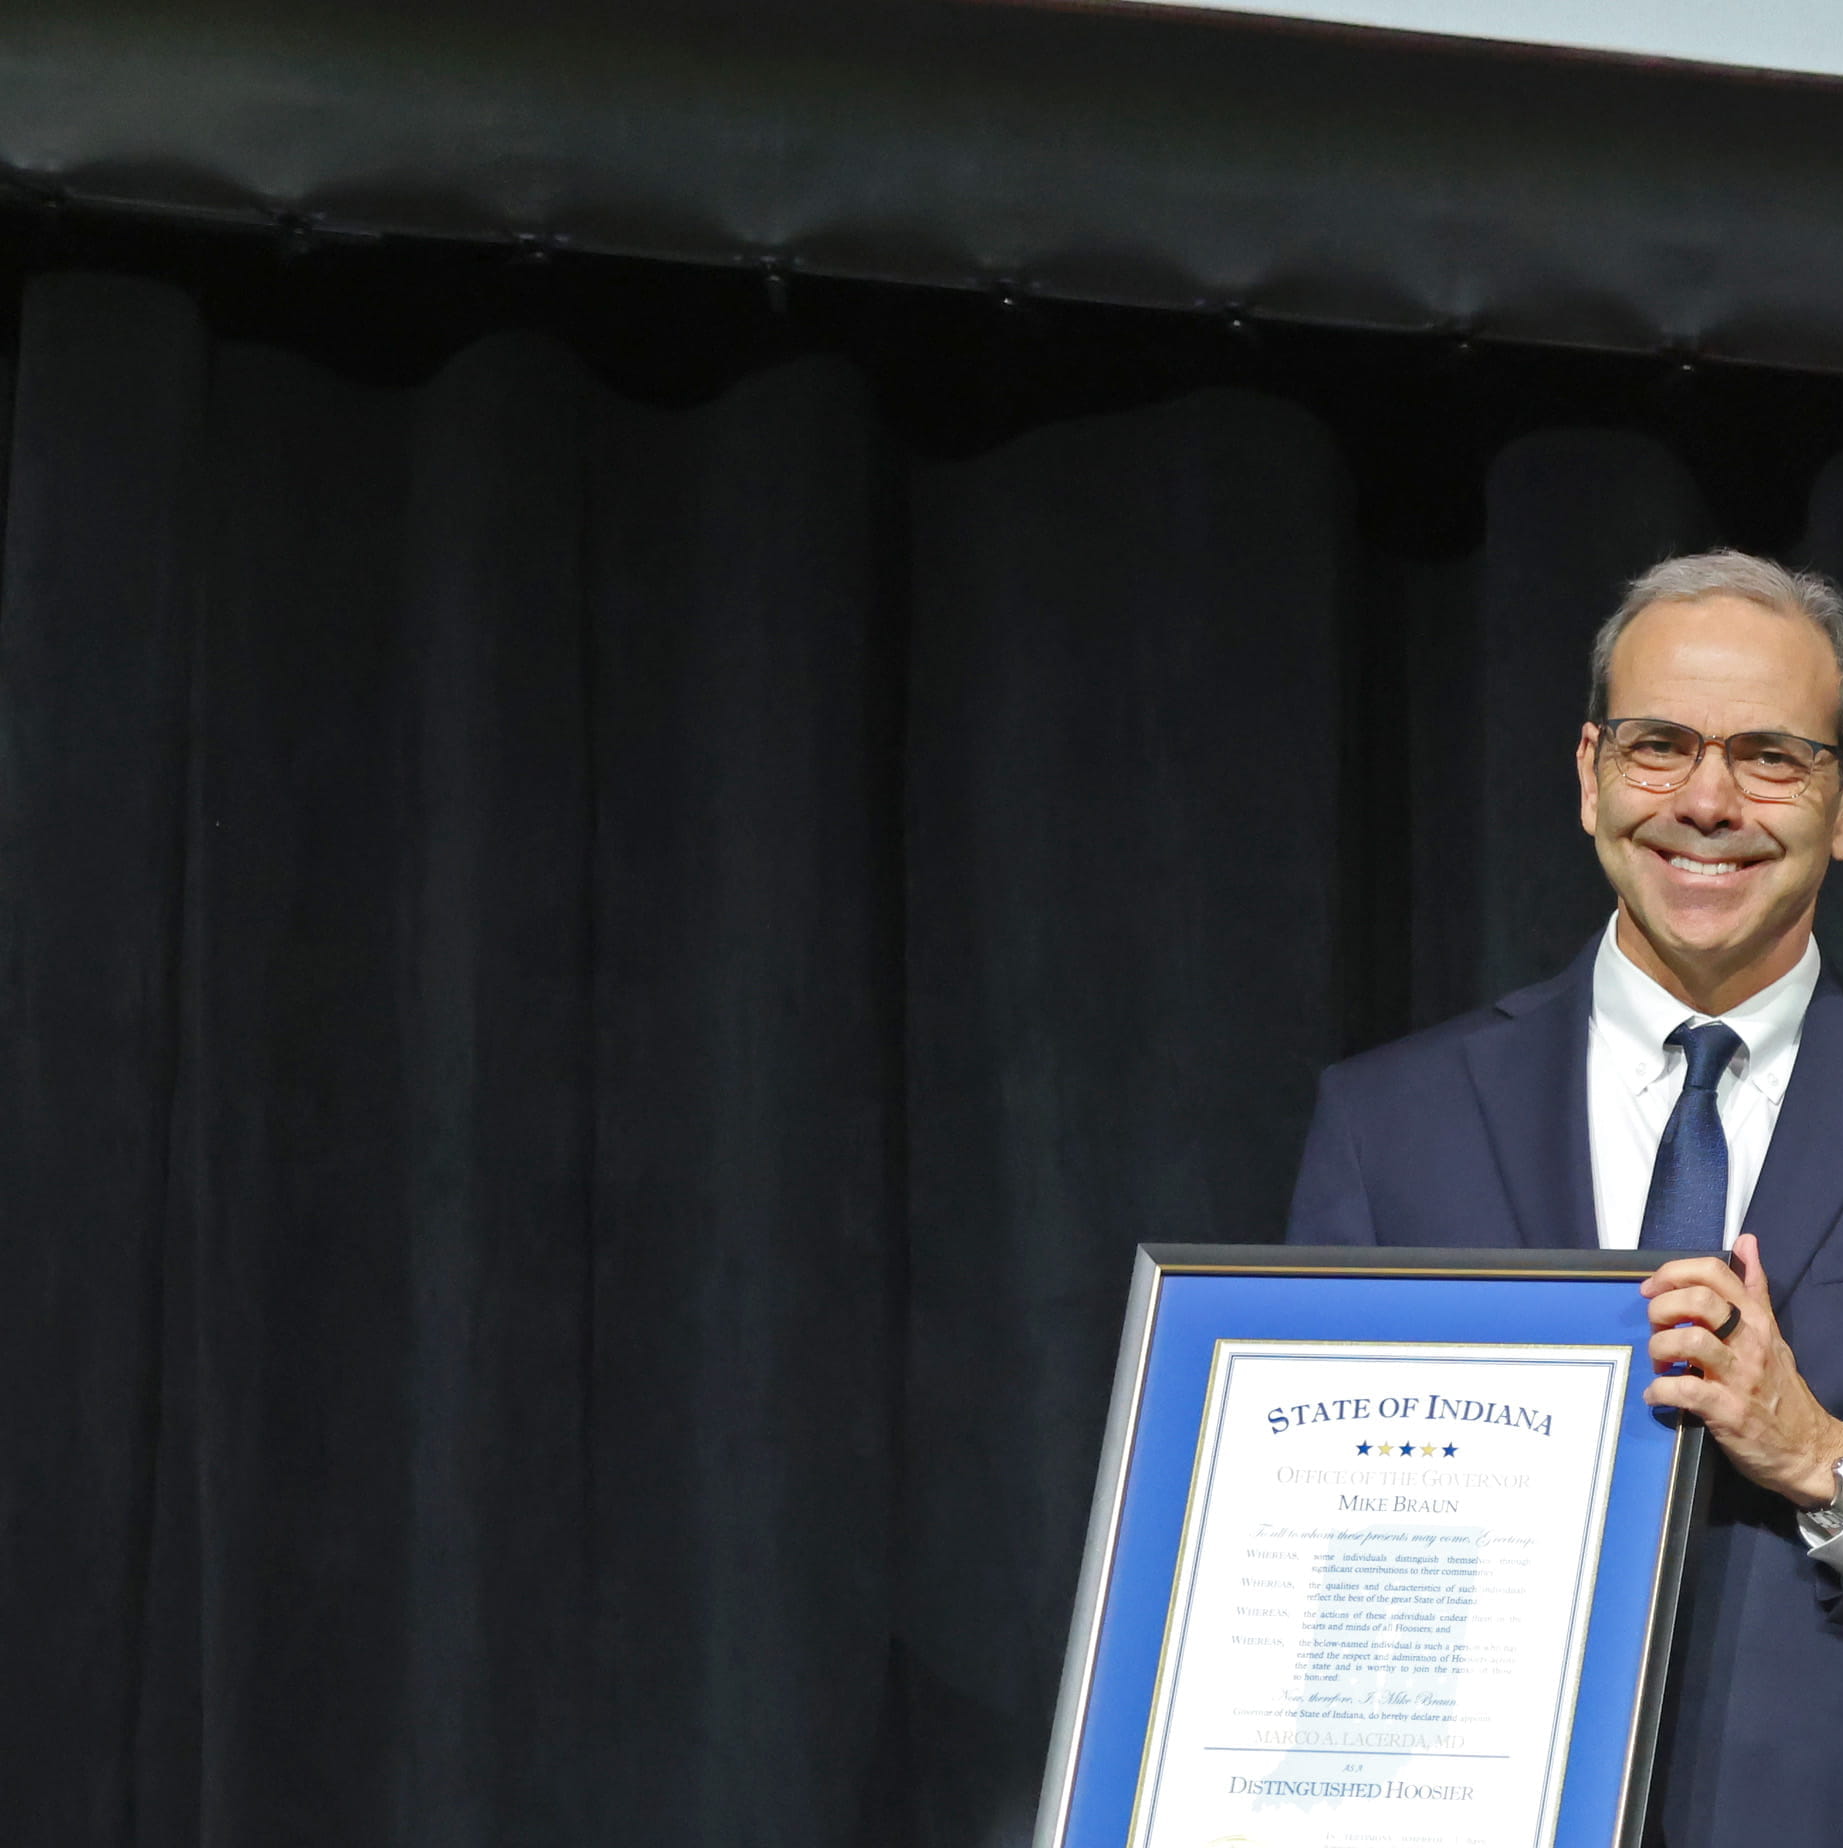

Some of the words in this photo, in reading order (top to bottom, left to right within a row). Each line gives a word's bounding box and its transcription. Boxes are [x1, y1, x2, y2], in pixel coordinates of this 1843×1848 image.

[1267, 1399, 1370, 1434] STATE
[1379, 1397, 1419, 1420] OF
[1424, 1394, 1553, 1437] INDIANA
[1276, 1465, 1347, 1486] OFFICE
[1350, 1470, 1376, 1486] OF
[1380, 1470, 1417, 1486] THE
[1421, 1469, 1531, 1489] GOVERNOR
[1338, 1494, 1388, 1512] MIKE
[1393, 1495, 1460, 1513] BRAUN
[1256, 1729, 1320, 1745] MARCO
[1341, 1731, 1430, 1749] LACERDA,
[1436, 1734, 1465, 1749] MD
[1227, 1775, 1382, 1798] DISTINGUISHED
[1384, 1780, 1474, 1801] HOOSIER
